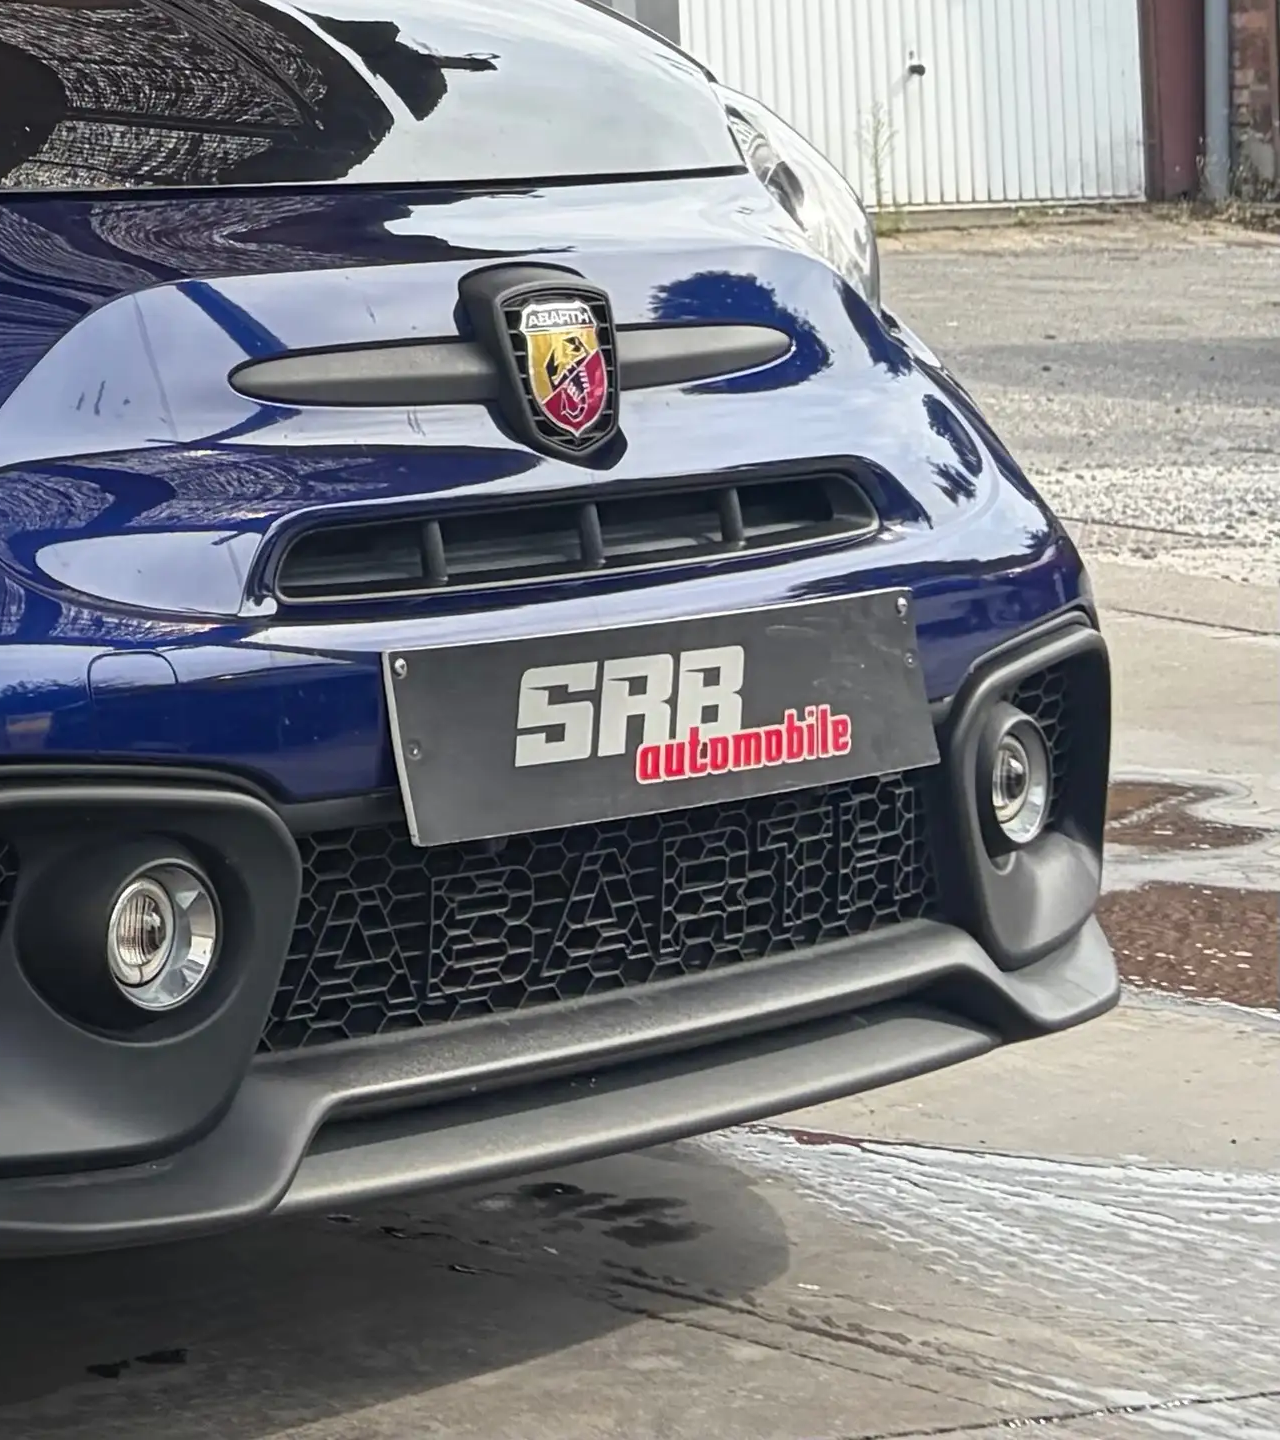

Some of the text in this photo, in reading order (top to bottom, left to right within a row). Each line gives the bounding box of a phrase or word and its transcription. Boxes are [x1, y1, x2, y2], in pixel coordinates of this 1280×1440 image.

[528, 311, 590, 327] ABARTH
[515, 645, 745, 768] SRB
[637, 704, 851, 783] automobile
[285, 786, 915, 1021] ABARTH
